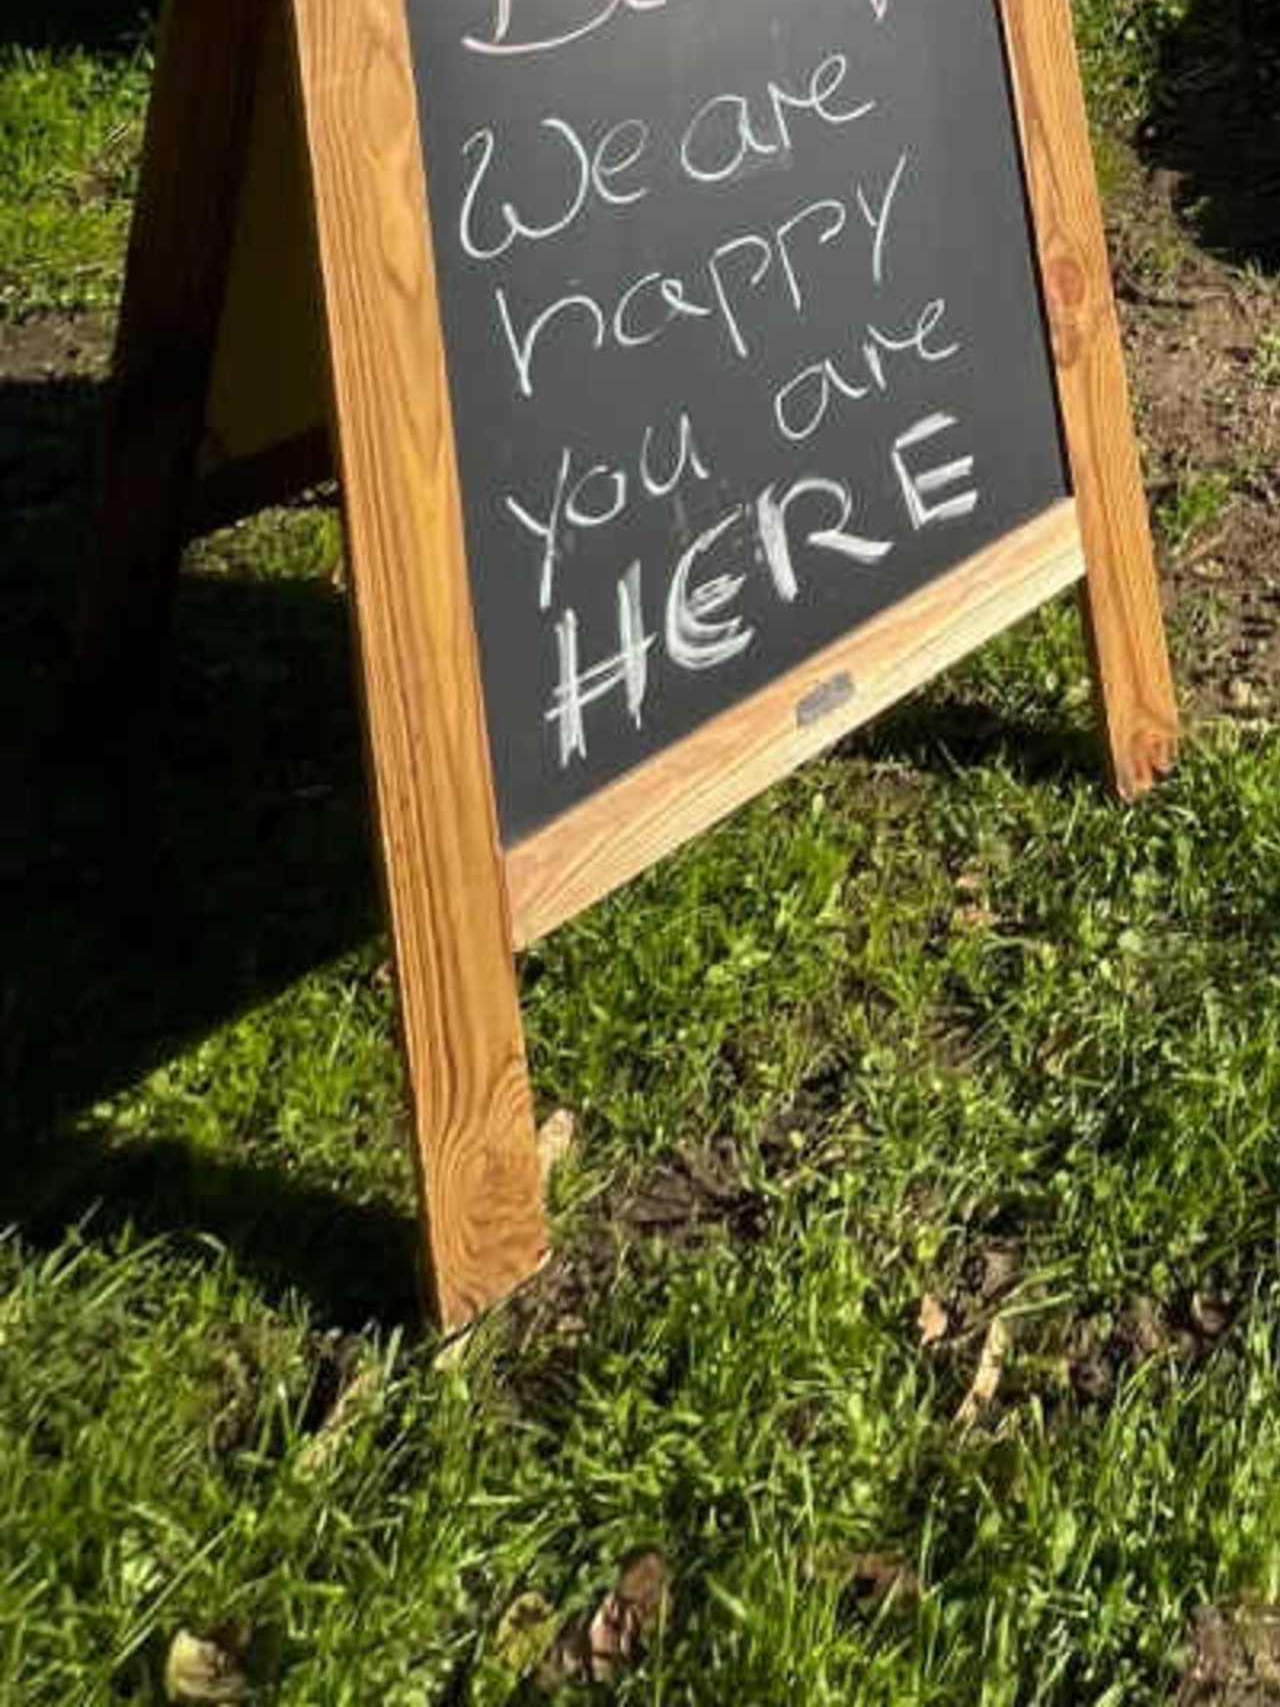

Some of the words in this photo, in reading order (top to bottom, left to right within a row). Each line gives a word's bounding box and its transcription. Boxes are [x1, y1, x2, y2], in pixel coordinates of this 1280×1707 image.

[459, 117, 649, 261] We
[681, 53, 873, 182] are
[494, 153, 906, 397] happy
[507, 413, 709, 608] you
[773, 298, 958, 441] are
[545, 411, 978, 768] HERE
